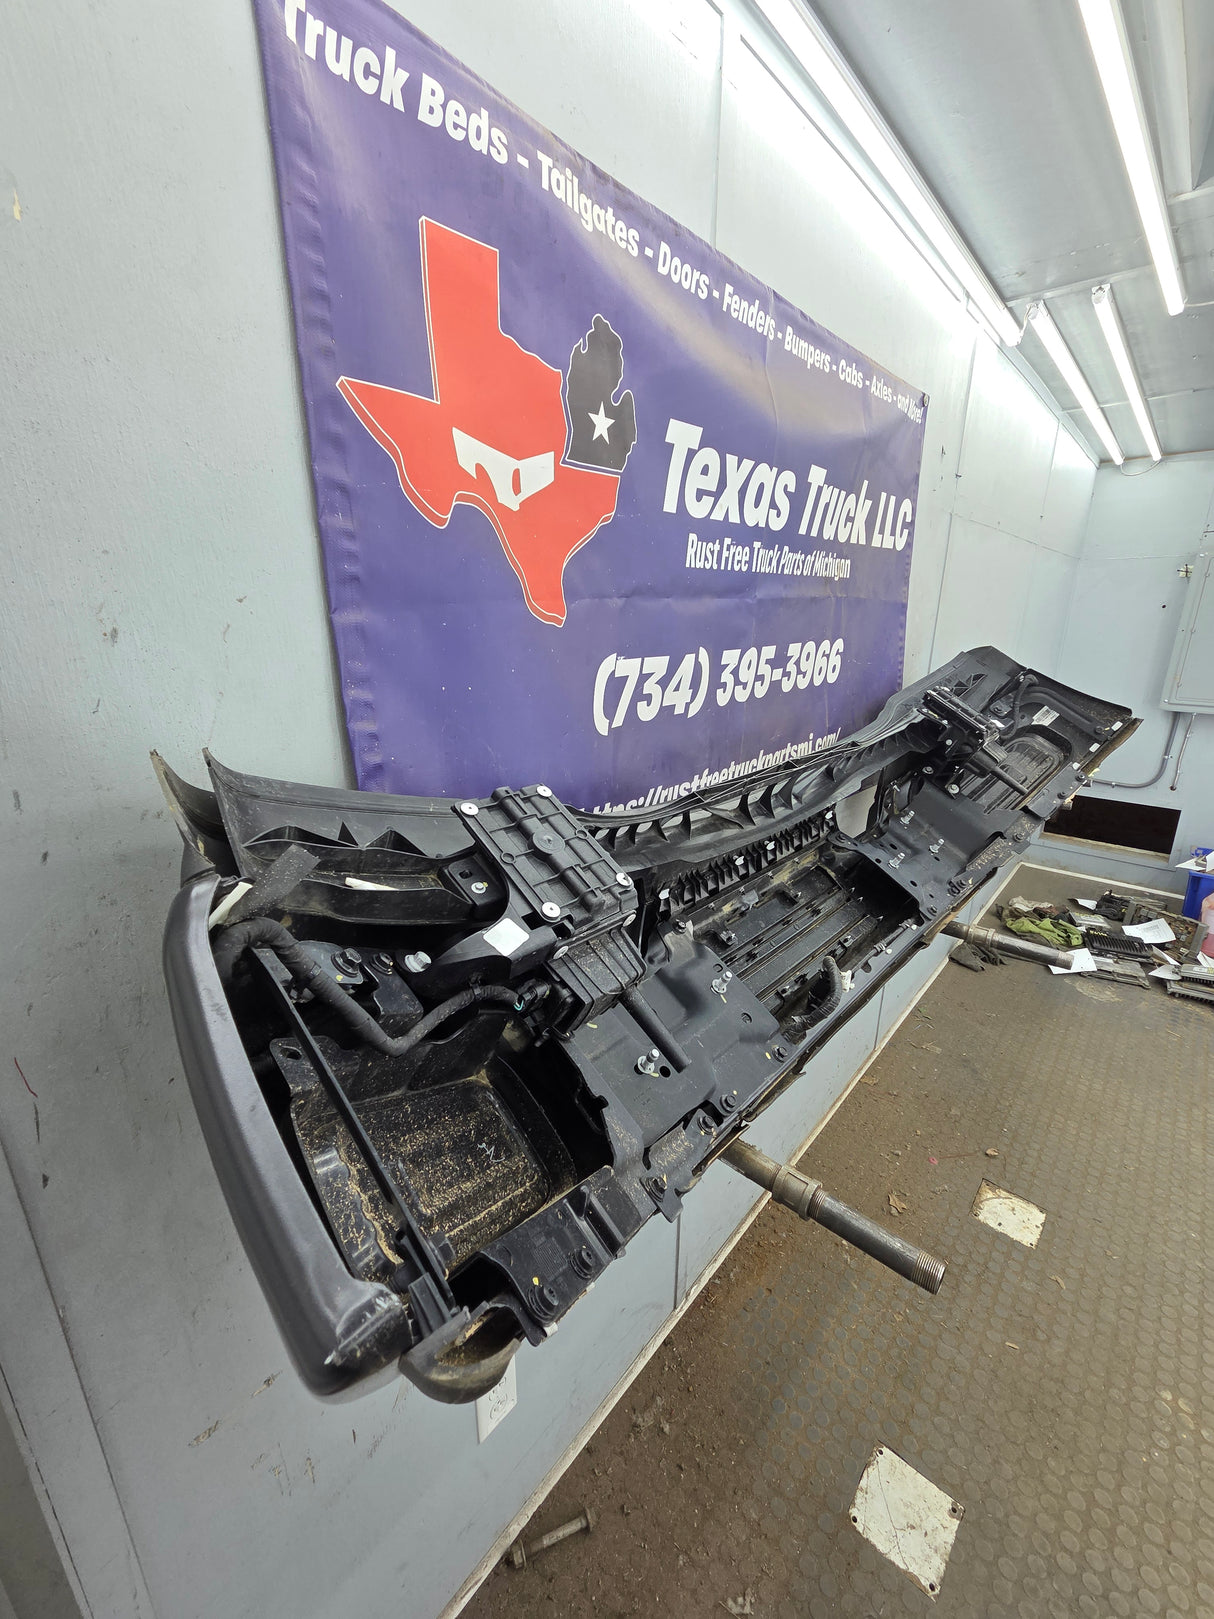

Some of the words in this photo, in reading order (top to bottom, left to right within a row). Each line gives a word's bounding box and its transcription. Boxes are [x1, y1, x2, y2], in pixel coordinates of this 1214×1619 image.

[283, 0, 410, 112] Truck
[417, 73, 508, 164] Beds
[537, 150, 640, 257] Tailgates
[657, 241, 710, 300] Doors
[722, 283, 776, 341] Fenders
[784, 325, 831, 373] Bumpers
[838, 359, 863, 388] Cabs
[871, 375, 892, 403] Axles
[897, 393, 910, 414] and
[663, 418, 796, 531] Texas
[798, 464, 873, 545] Truck
[871, 491, 912, 551] LLC
[685, 533, 720, 570] Rust
[720, 537, 750, 572] Free
[752, 541, 780, 574] Truck
[778, 545, 805, 576] Parts
[803, 550, 816, 576] of
[812, 550, 850, 581] Michigan
[593, 646, 710, 736] (734)
[716, 638, 844, 707] 395-3966
[578, 727, 841, 815] s://rustfreetruckpartsmi.com/
